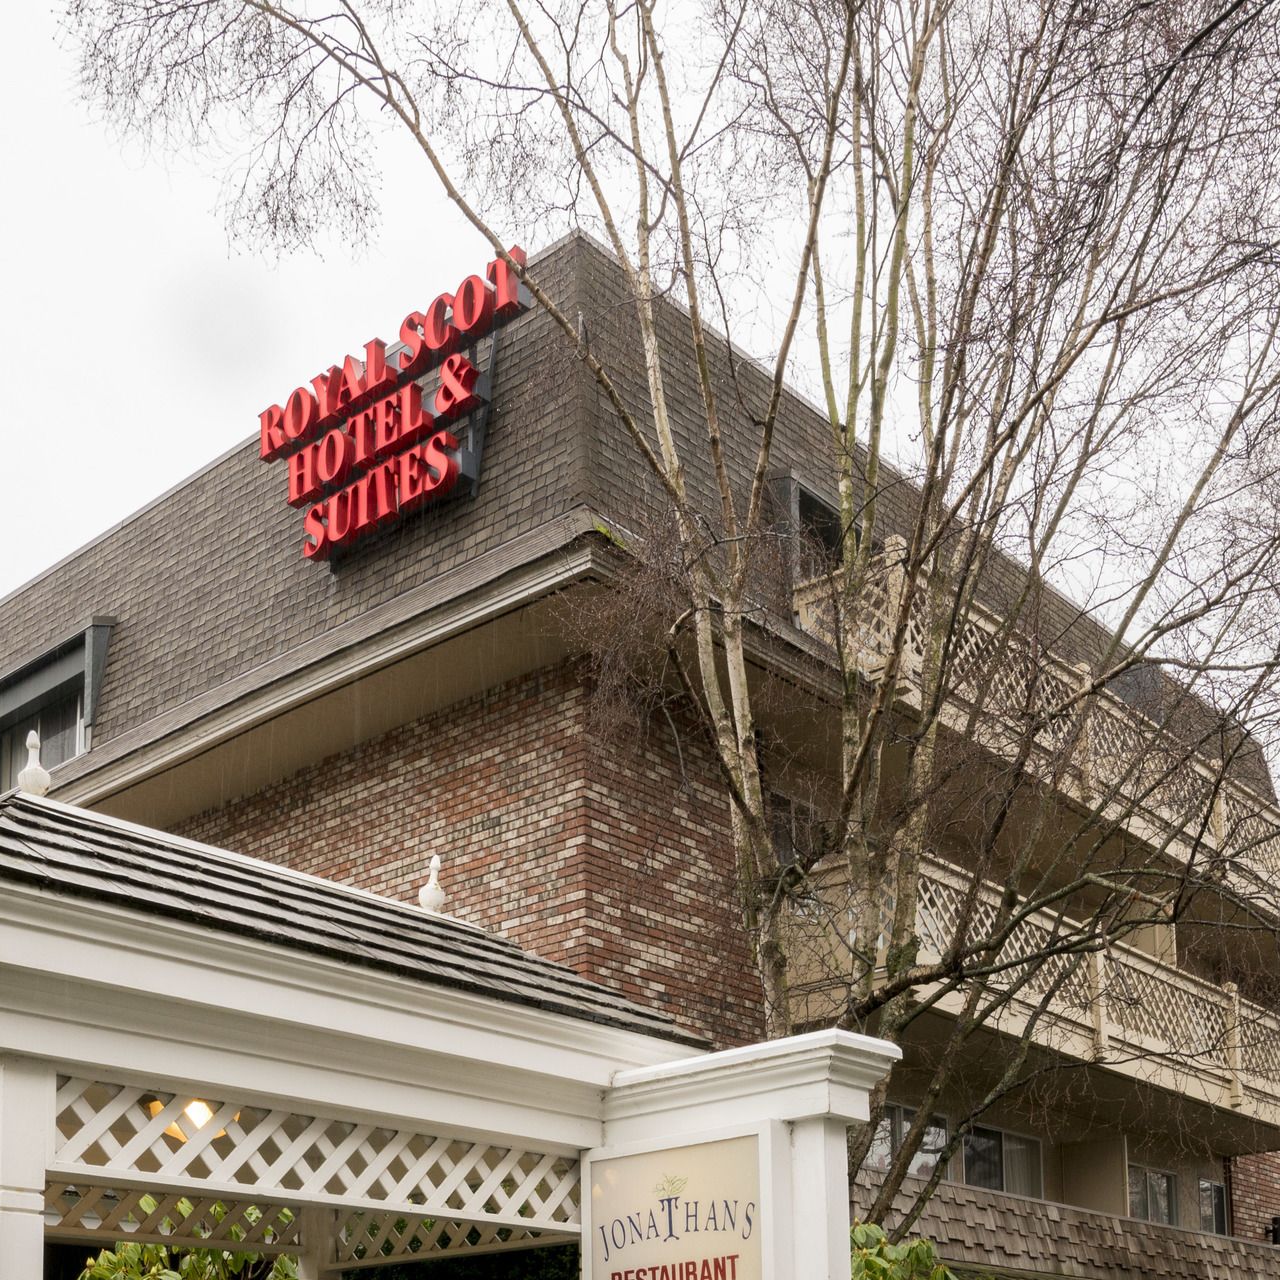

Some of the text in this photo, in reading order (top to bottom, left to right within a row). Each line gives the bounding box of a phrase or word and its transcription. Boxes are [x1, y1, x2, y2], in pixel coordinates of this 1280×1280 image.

[258, 245, 527, 463] ROYAL SCOT
[287, 353, 479, 509] HOTEL &
[303, 431, 460, 562] SUITES
[599, 1196, 756, 1262] JONATHANS
